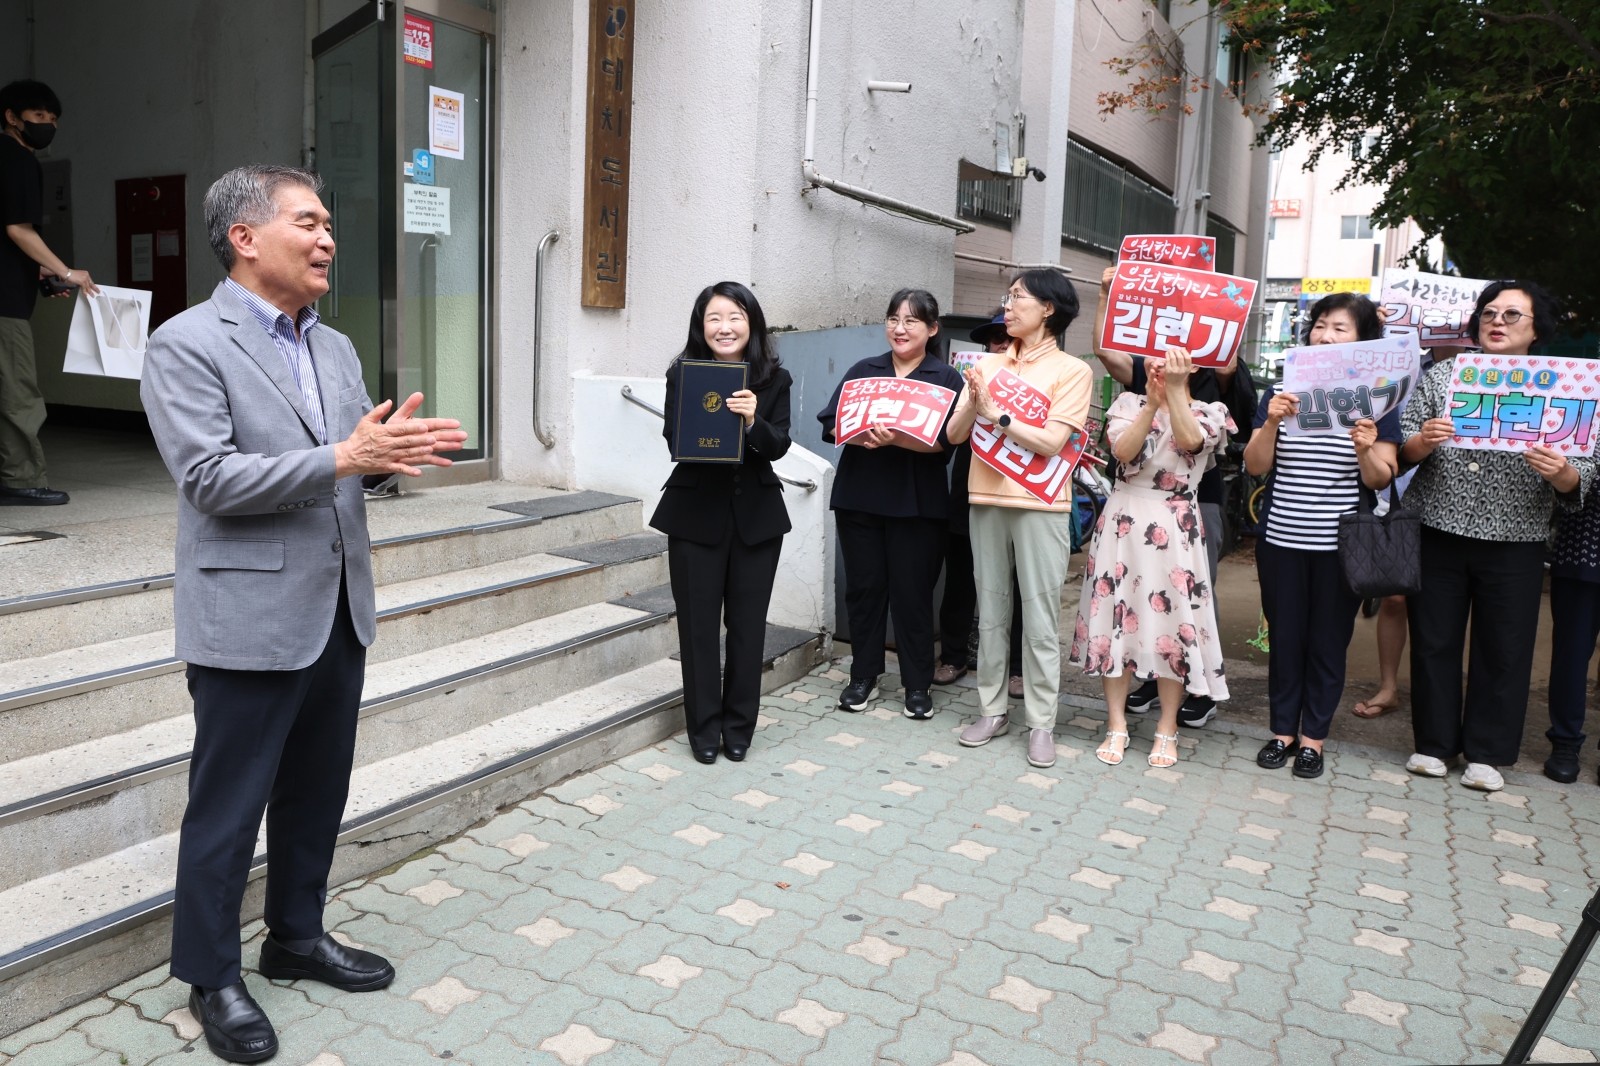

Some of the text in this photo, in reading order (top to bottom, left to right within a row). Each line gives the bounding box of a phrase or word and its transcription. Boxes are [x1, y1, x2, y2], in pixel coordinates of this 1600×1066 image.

[598, 57, 624, 284] 대치도서관
[1122, 239, 1196, 262] 응원합니다
[1118, 266, 1218, 299] 응원합니다
[1305, 280, 1338, 292] 성창
[1391, 279, 1477, 305] 사랑합니
[1118, 293, 1154, 304] 강남구청장
[1112, 301, 1240, 363] 김현기
[1354, 350, 1413, 372] 멋지다
[844, 380, 925, 398] 응원합니다
[1463, 368, 1551, 385] 응원해요
[1291, 375, 1411, 430] 김현기
[840, 397, 942, 439] 김현기
[1450, 391, 1597, 445] 김현기
